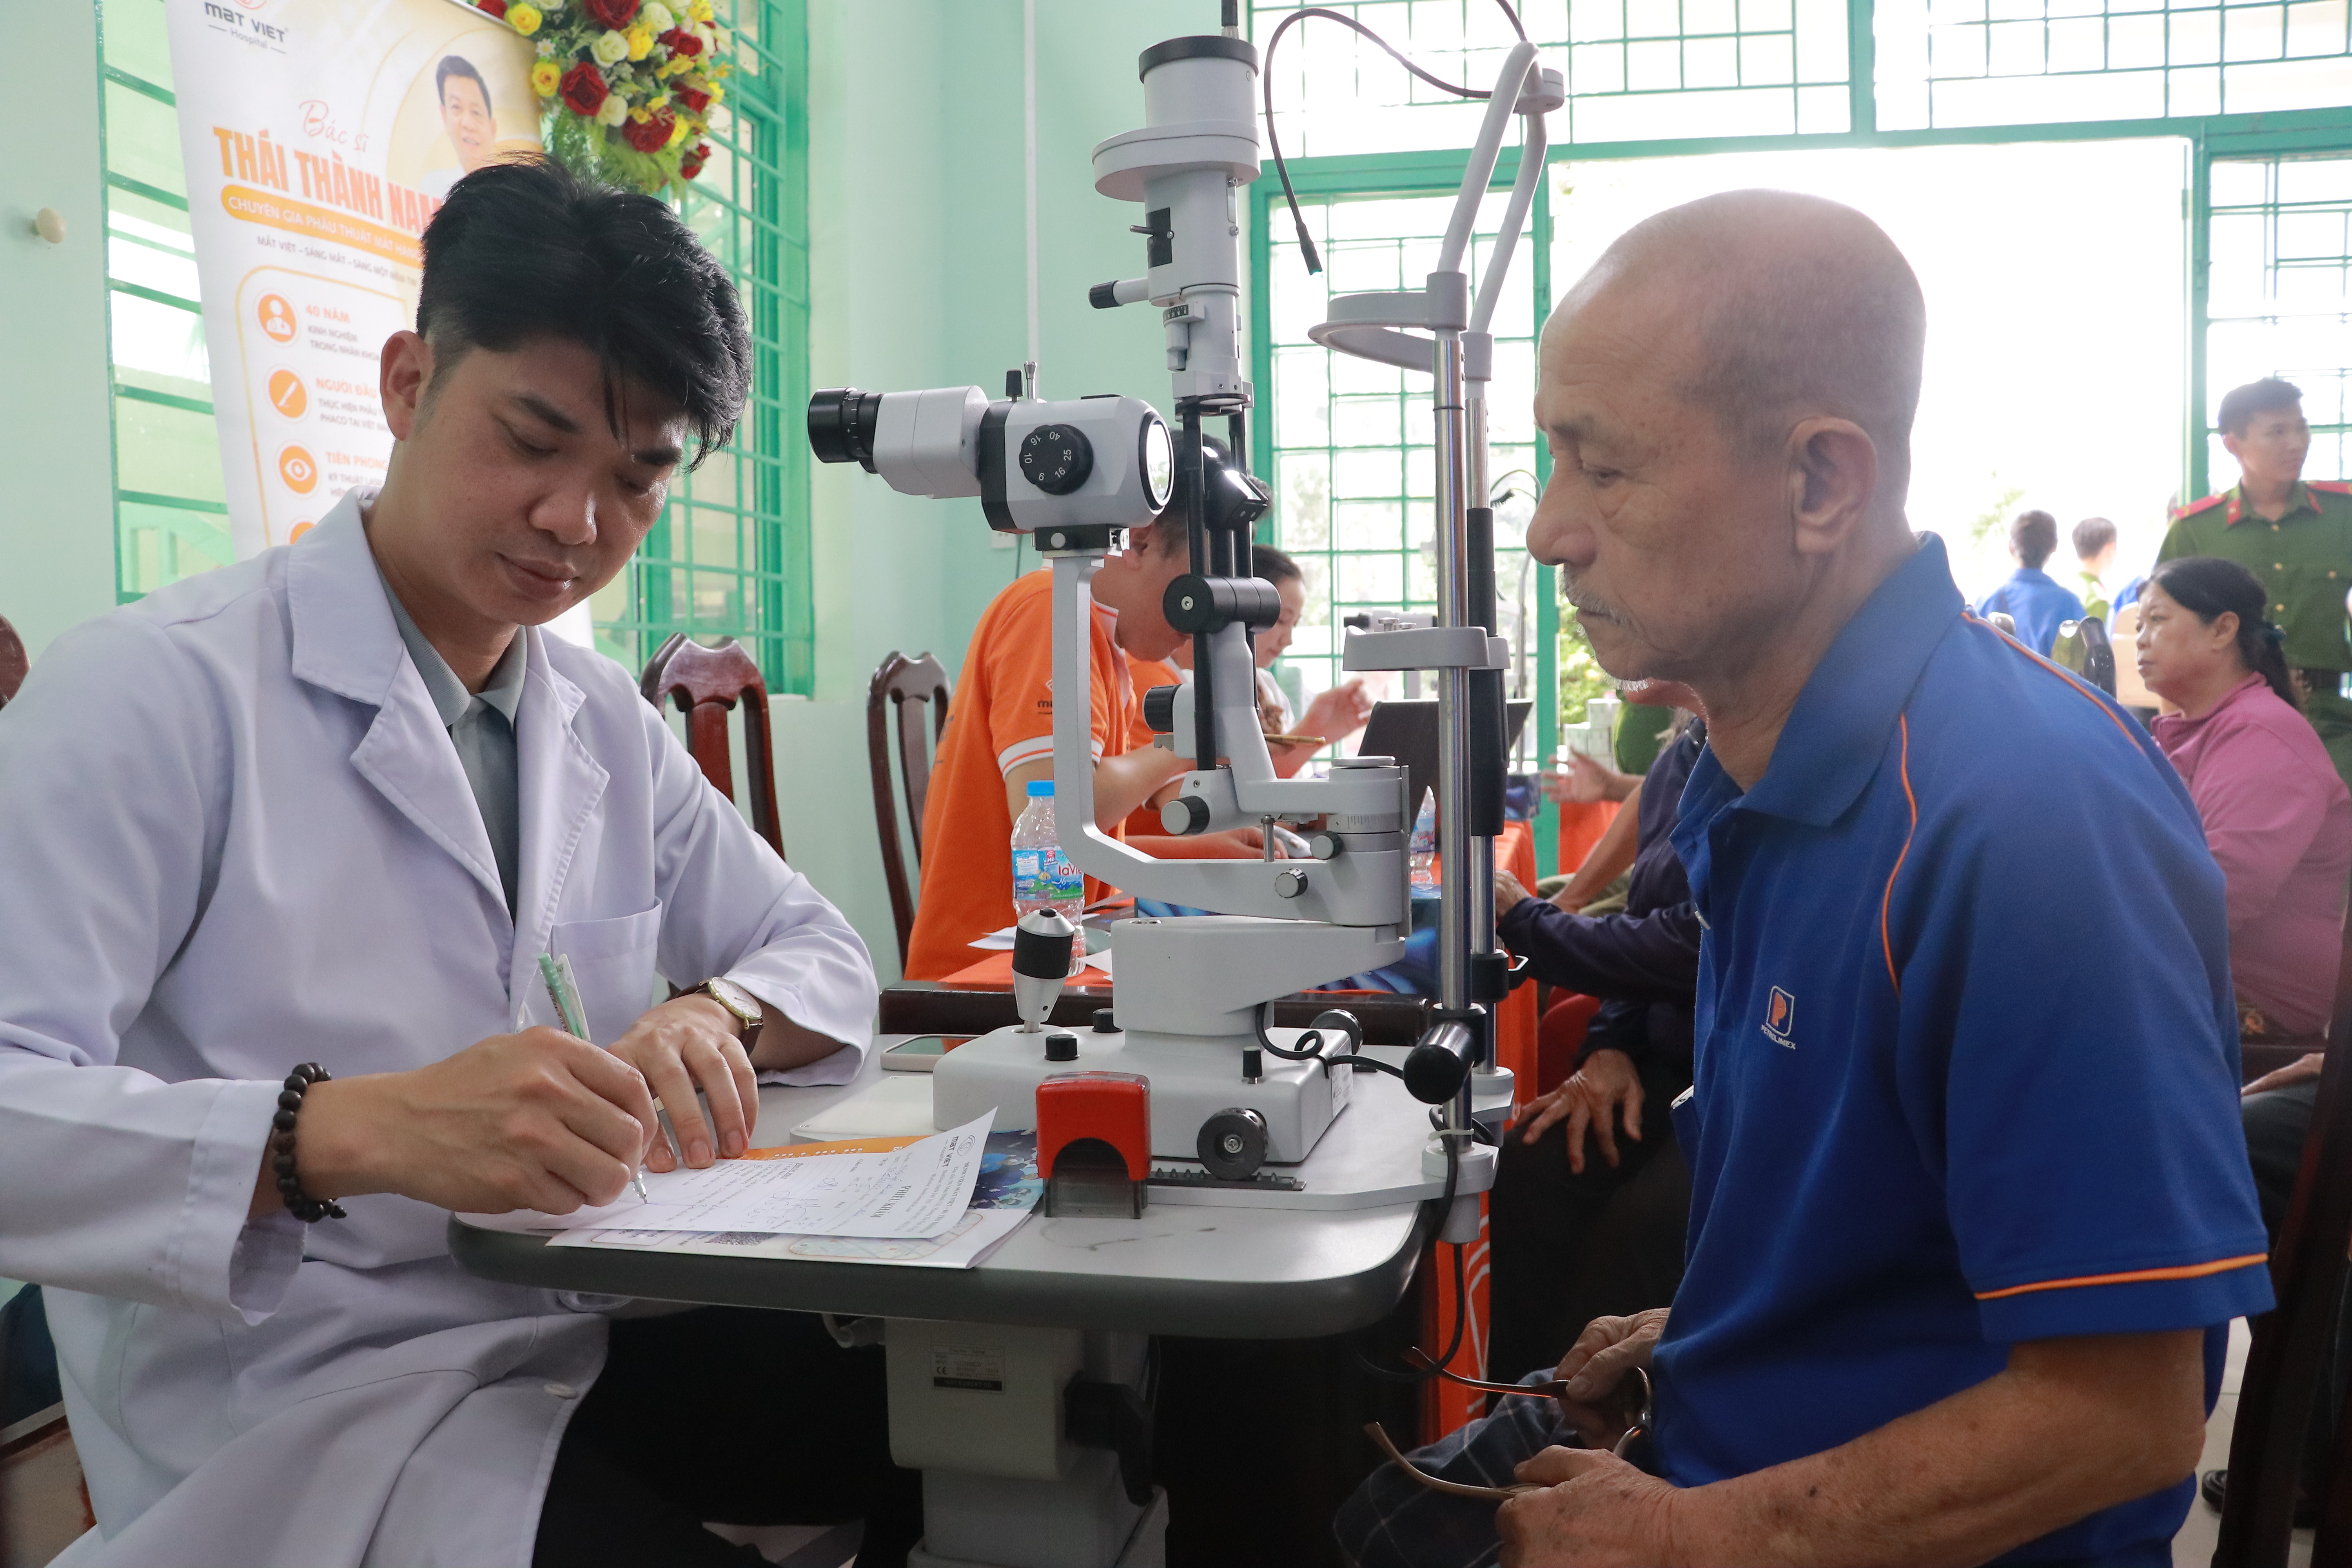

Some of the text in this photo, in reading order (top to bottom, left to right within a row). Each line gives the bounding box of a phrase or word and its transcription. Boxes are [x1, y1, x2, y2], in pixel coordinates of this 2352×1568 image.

[251, 18, 285, 42] VIET
[231, 27, 268, 49] Hospital
[299, 100, 348, 144] Bác
[213, 126, 289, 192] THÁI
[294, 148, 384, 220] THÀNH
[228, 196, 280, 220] CHUYÊN
[283, 209, 304, 225] GIA
[279, 241, 296, 253] VIỆT
[305, 246, 327, 260] SÁNG
[306, 304, 320, 317] 40
[1031, 435, 1041, 446] 16
[1049, 431, 1061, 441] 40
[1024, 453, 1033, 464] 10
[1063, 449, 1072, 461] 25
[1039, 472, 1045, 481] 6
[1055, 467, 1065, 478] 16
[942, 1152, 953, 1167] VIET
[888, 1185, 912, 1202] PHIẾU
[870, 1203, 896, 1218] KHÁM
[936, 1366, 947, 1376] CE
